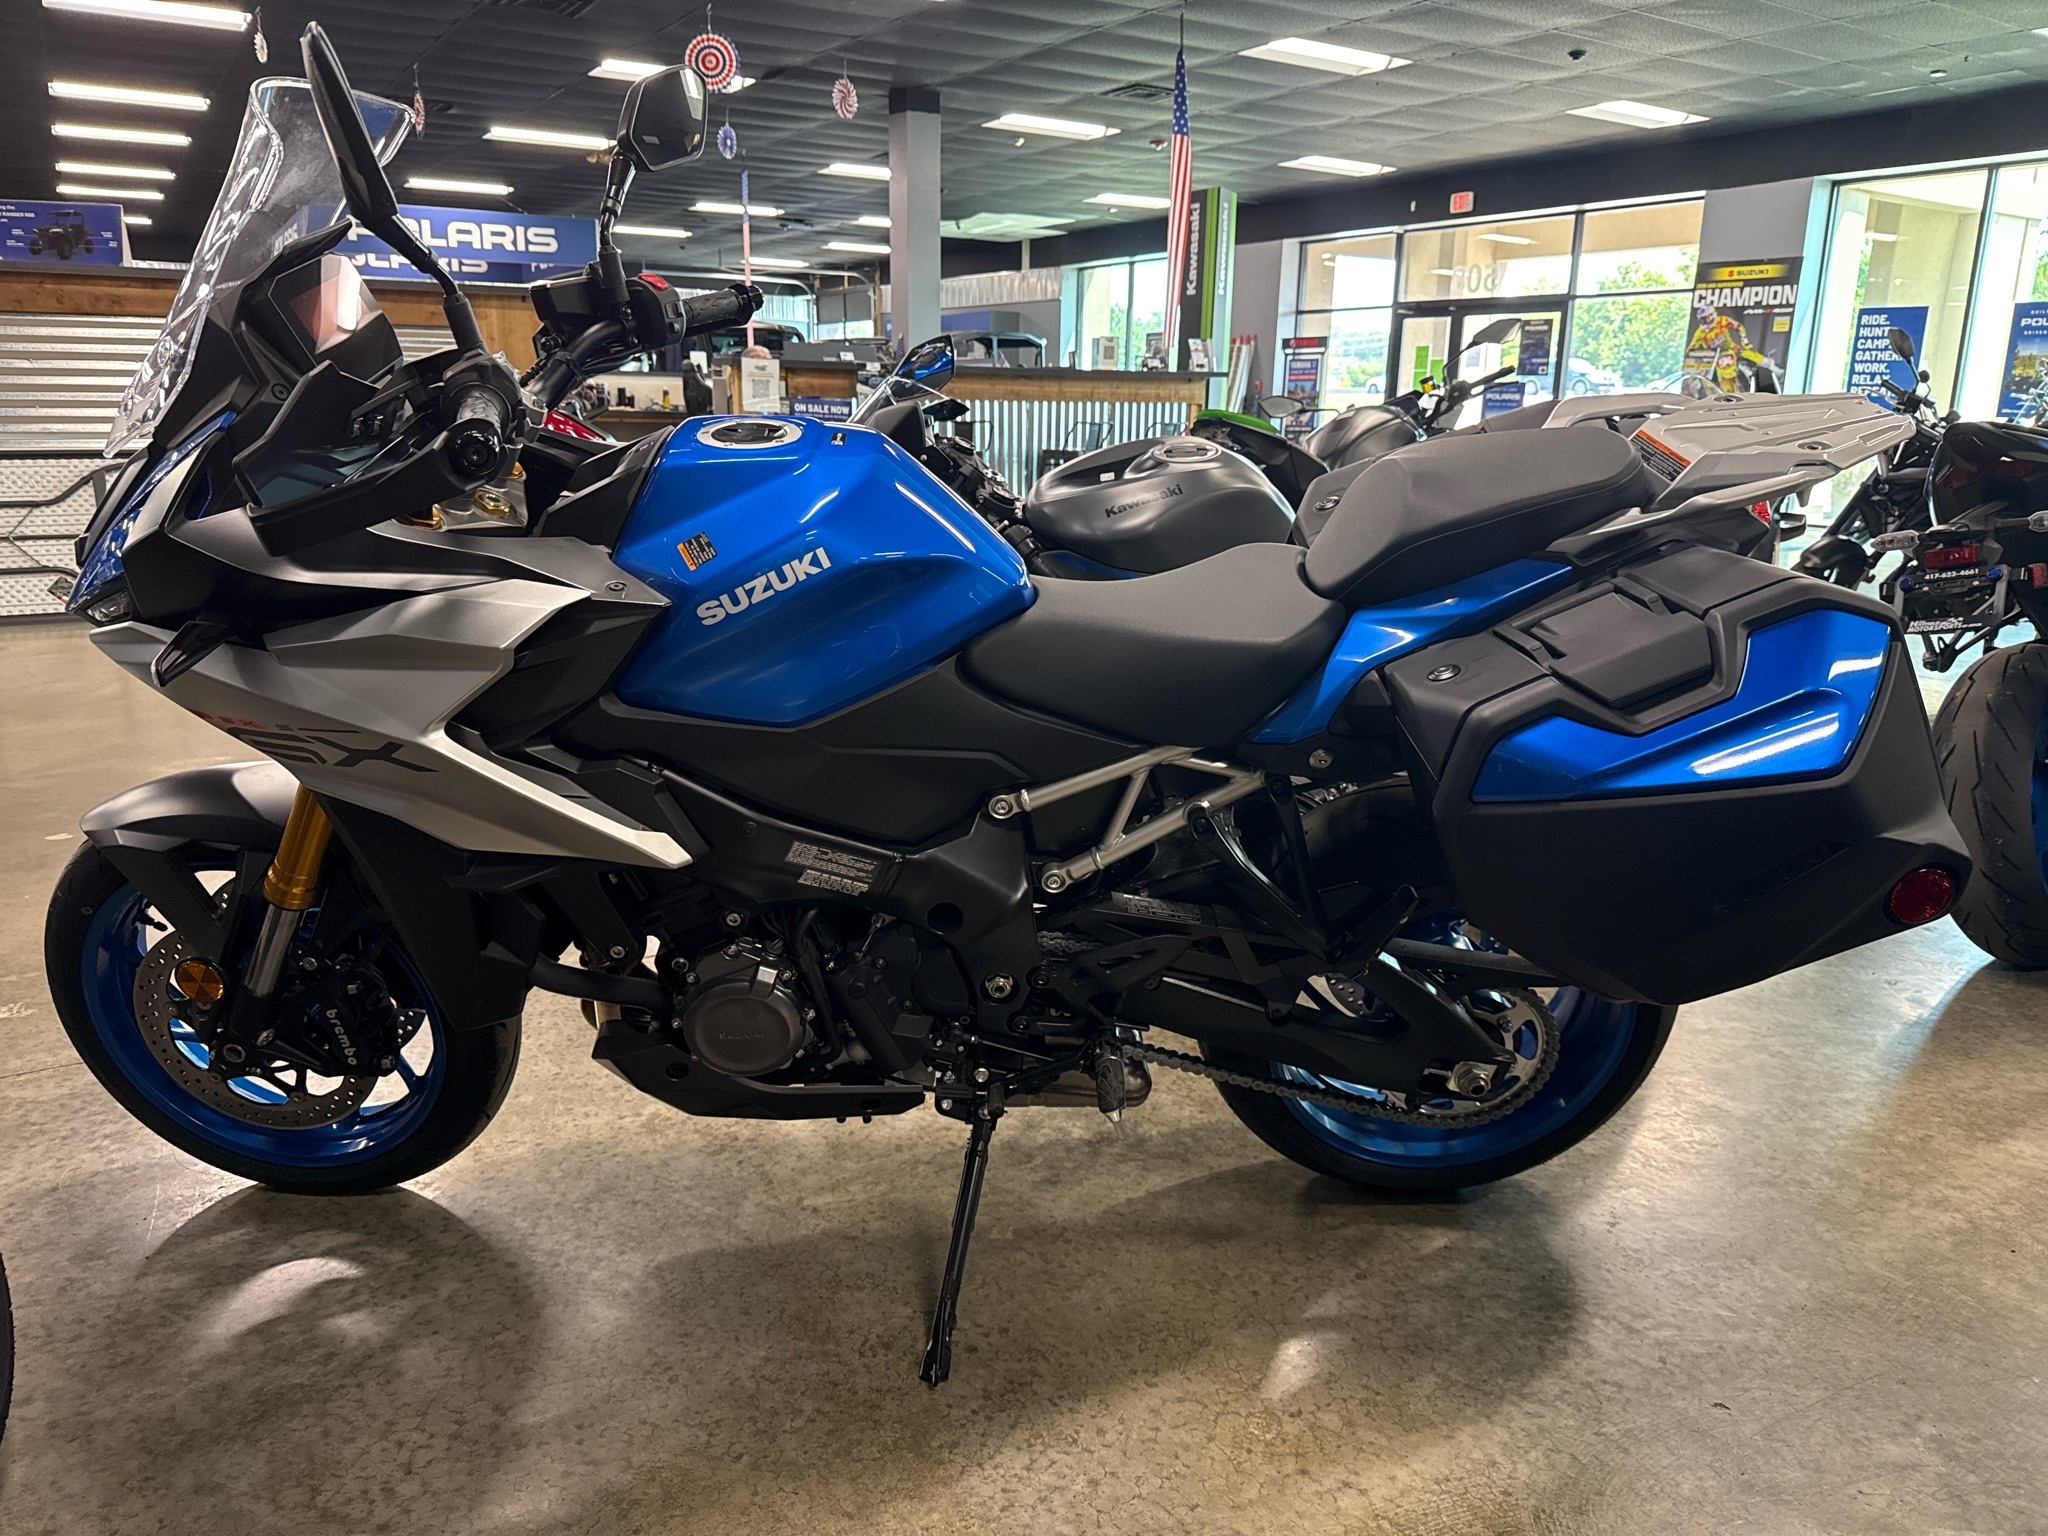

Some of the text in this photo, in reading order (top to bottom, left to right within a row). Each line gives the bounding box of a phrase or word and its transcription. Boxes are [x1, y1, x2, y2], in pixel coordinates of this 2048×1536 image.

[1186, 202, 1201, 296] Kawasaki
[1218, 201, 1230, 296] Kawasaki
[1736, 268, 1769, 277] SUZUKI
[1692, 284, 1798, 309] CHAMPION
[1860, 314, 1891, 326] RIDE.
[1857, 338, 1892, 350] CAMP.
[1853, 363, 1891, 374] WORK.
[1484, 393, 1521, 401] POLARIS
[794, 403, 850, 415] ON SALE NOW
[1104, 483, 1185, 519] Kawasaki
[1924, 568, 1979, 580] 417-623-4661
[696, 546, 832, 626] SUZUKI
[1906, 621, 1963, 633] MOTORSPORTS
[325, 1008, 358, 1066] brembo
